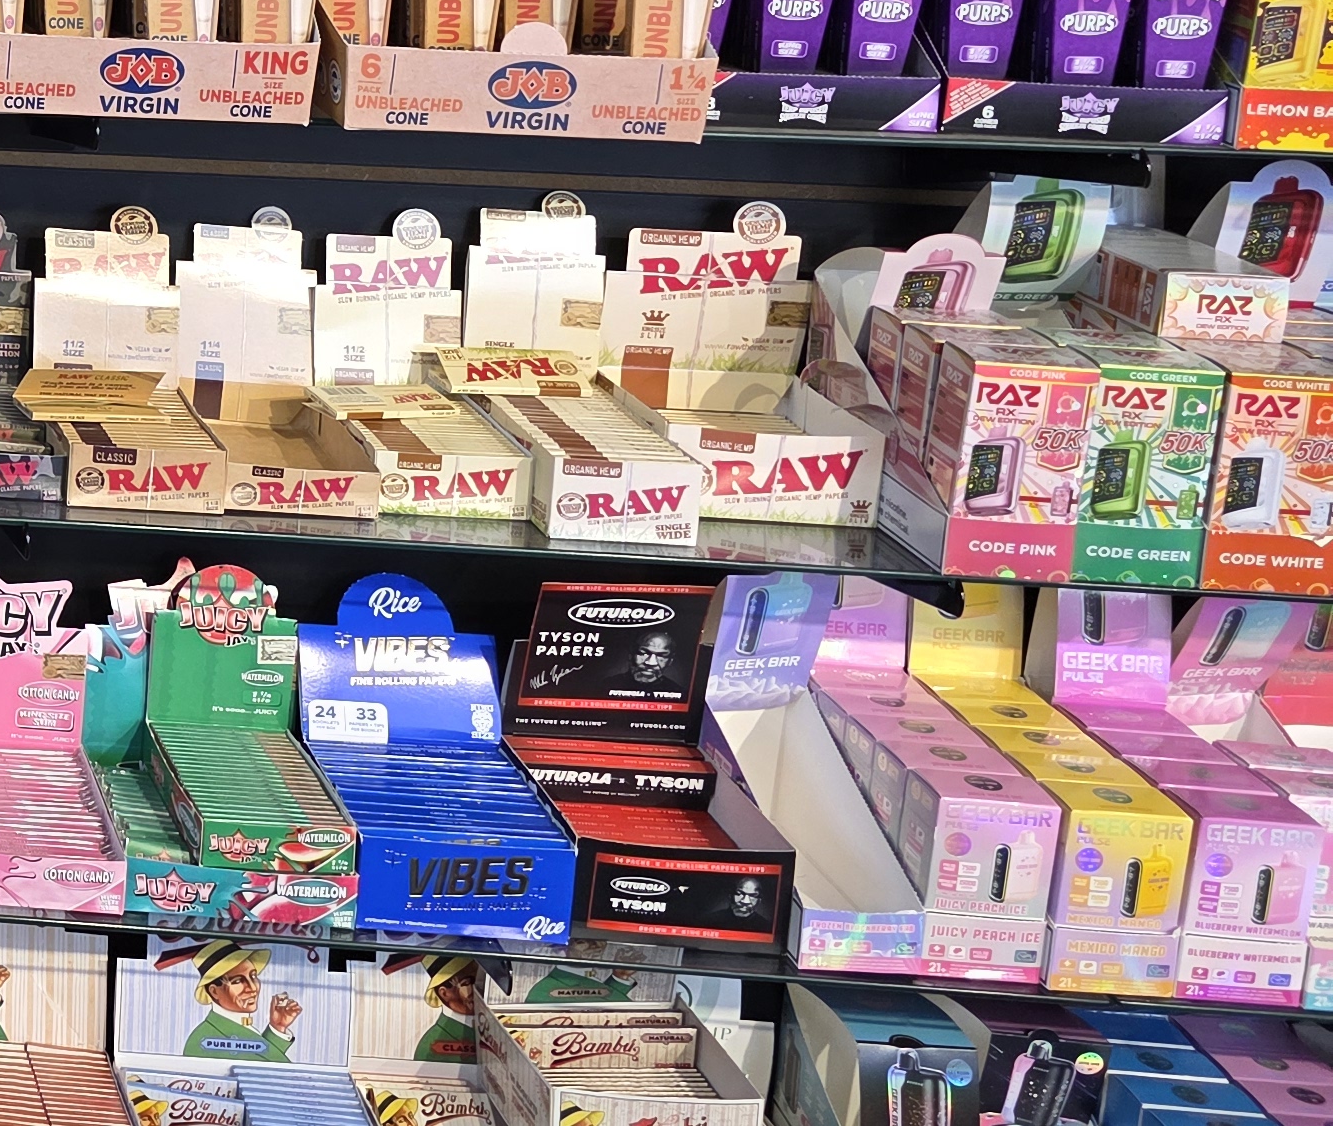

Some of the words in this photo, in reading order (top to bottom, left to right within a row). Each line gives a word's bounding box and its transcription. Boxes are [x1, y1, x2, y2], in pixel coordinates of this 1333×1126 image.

[244, 51, 308, 75] KING
[102, 54, 180, 90] JOB
[99, 96, 179, 115] VIRGIN
[1100, 386, 1167, 411] RAZ
[95, 450, 135, 463] CLASSIC
[105, 462, 210, 494] RAW
[710, 449, 866, 497] RAW
[655, 523, 692, 532] SINGLE
[656, 530, 692, 540] WIDE
[969, 540, 1014, 554] CODE
[1018, 542, 1057, 556] PINK
[369, 588, 422, 619] Rice
[575, 606, 668, 621] FUTUROLA
[538, 632, 601, 643] TYSON
[535, 646, 605, 657] PAPERS
[1062, 653, 1117, 672] GEEK
[1121, 655, 1162, 673] BAR
[43, 868, 78, 883] COTTON
[81, 869, 114, 883] CANDY
[408, 857, 533, 897] VIBES
[931, 926, 965, 938] JUICY
[973, 928, 1016, 941] PEACH
[1021, 931, 1041, 943] ICE
[556, 989, 605, 998] NATURAL
[206, 1040, 231, 1049] PURE
[235, 1042, 262, 1052] HEMP
